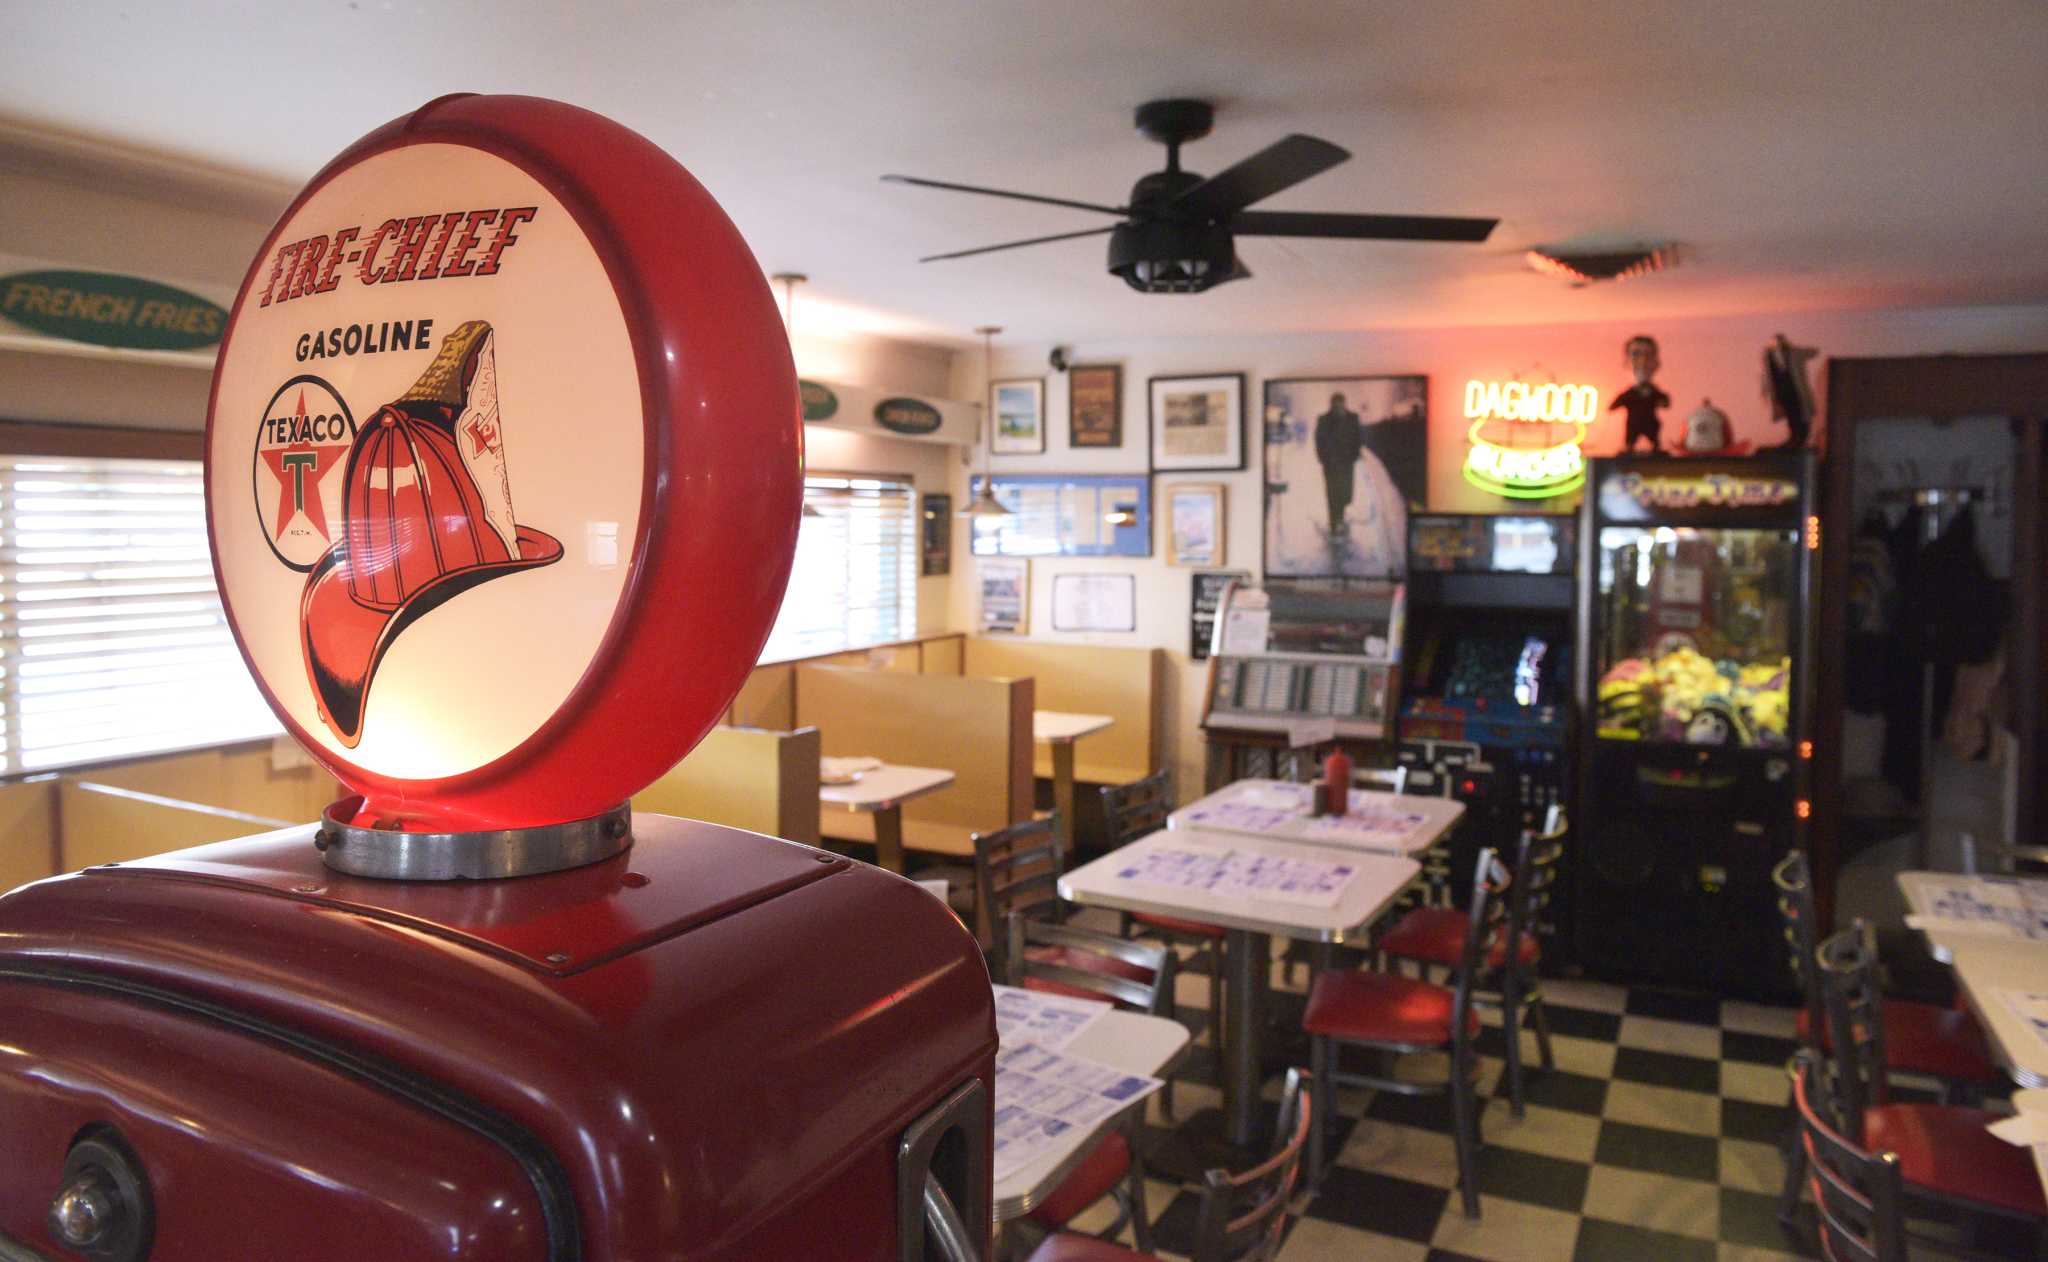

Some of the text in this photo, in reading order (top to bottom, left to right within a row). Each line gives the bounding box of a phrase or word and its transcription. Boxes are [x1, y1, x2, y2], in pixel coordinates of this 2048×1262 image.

[260, 206, 538, 308] FIRE-CHIEF
[5, 283, 222, 336] FRENCH FRIES
[295, 318, 434, 362] GASOLINE
[1464, 379, 1599, 424] DAGWOOD
[266, 413, 346, 445] TEXACO
